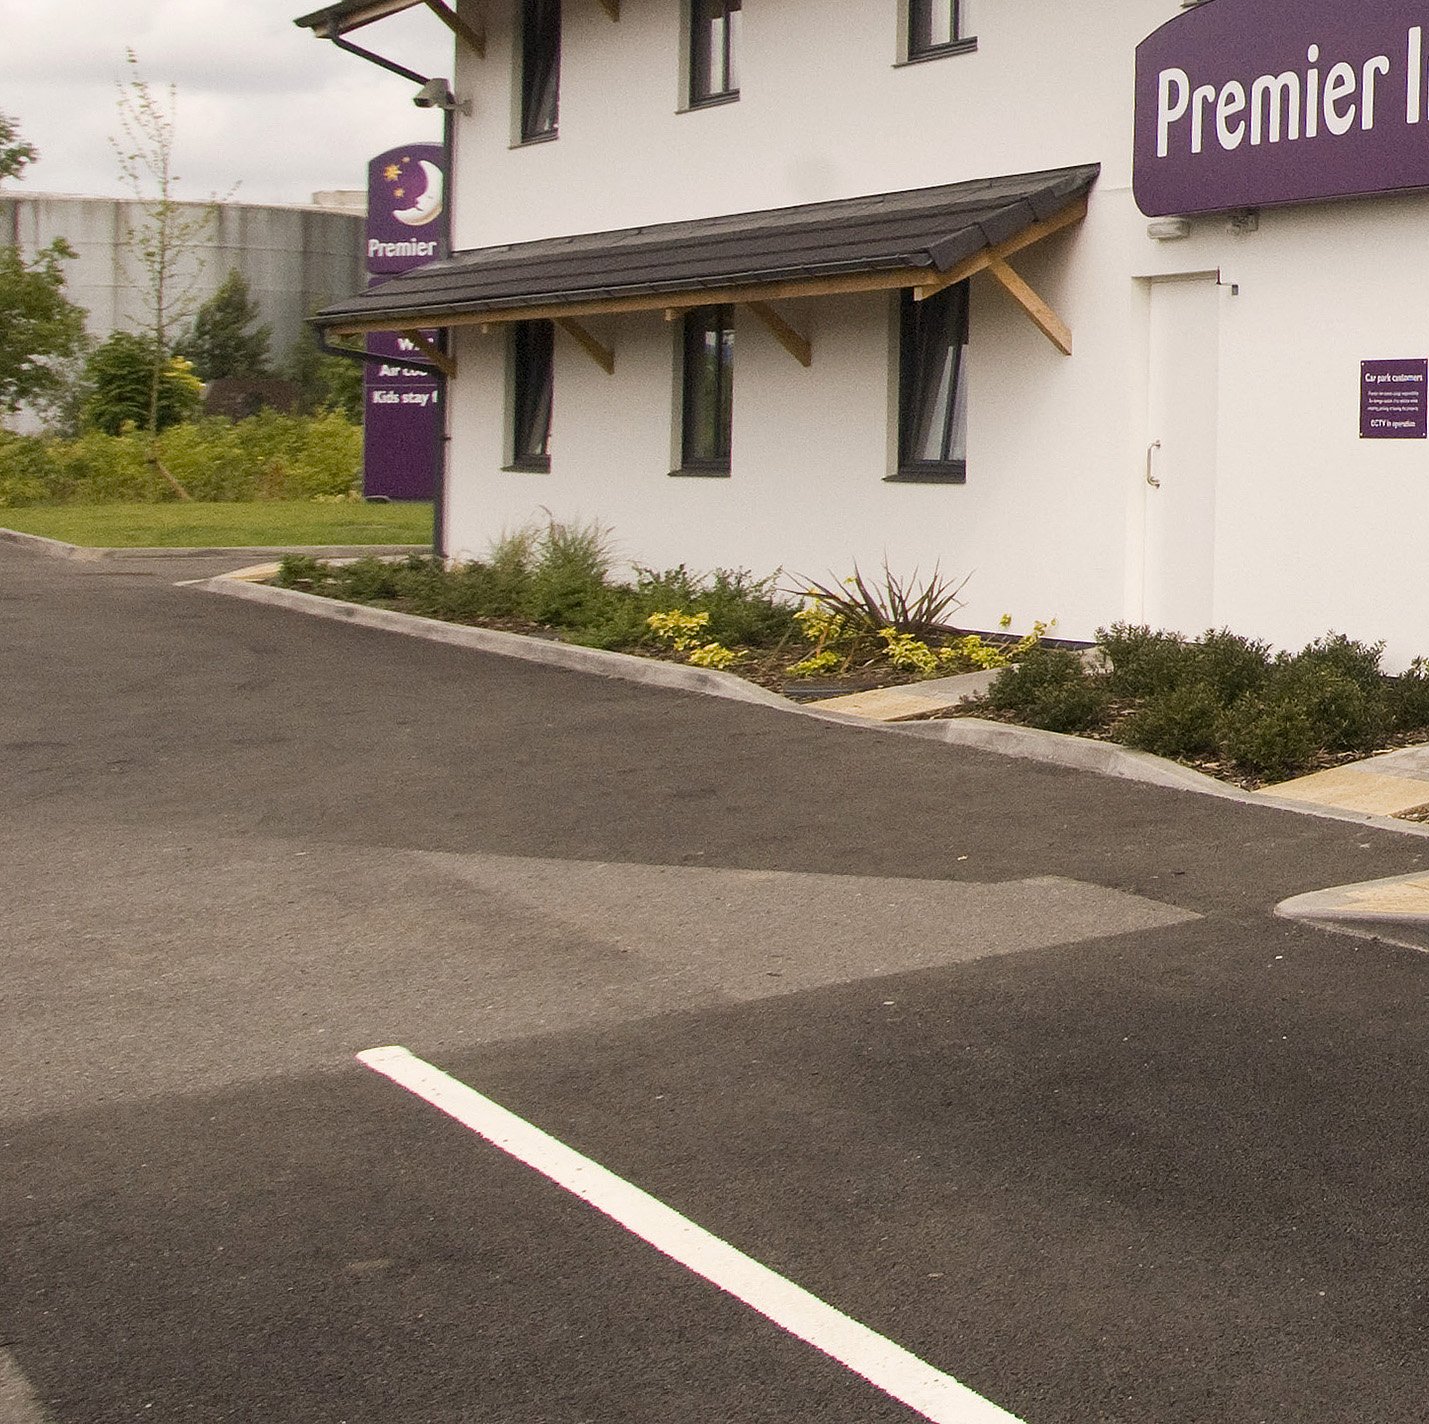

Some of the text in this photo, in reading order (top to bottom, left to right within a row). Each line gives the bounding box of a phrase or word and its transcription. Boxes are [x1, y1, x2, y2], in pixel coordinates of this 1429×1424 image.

[1157, 44, 1390, 158] Premier
[367, 237, 438, 257] Premier
[373, 391, 400, 404] Kids
[401, 391, 430, 407] stay
